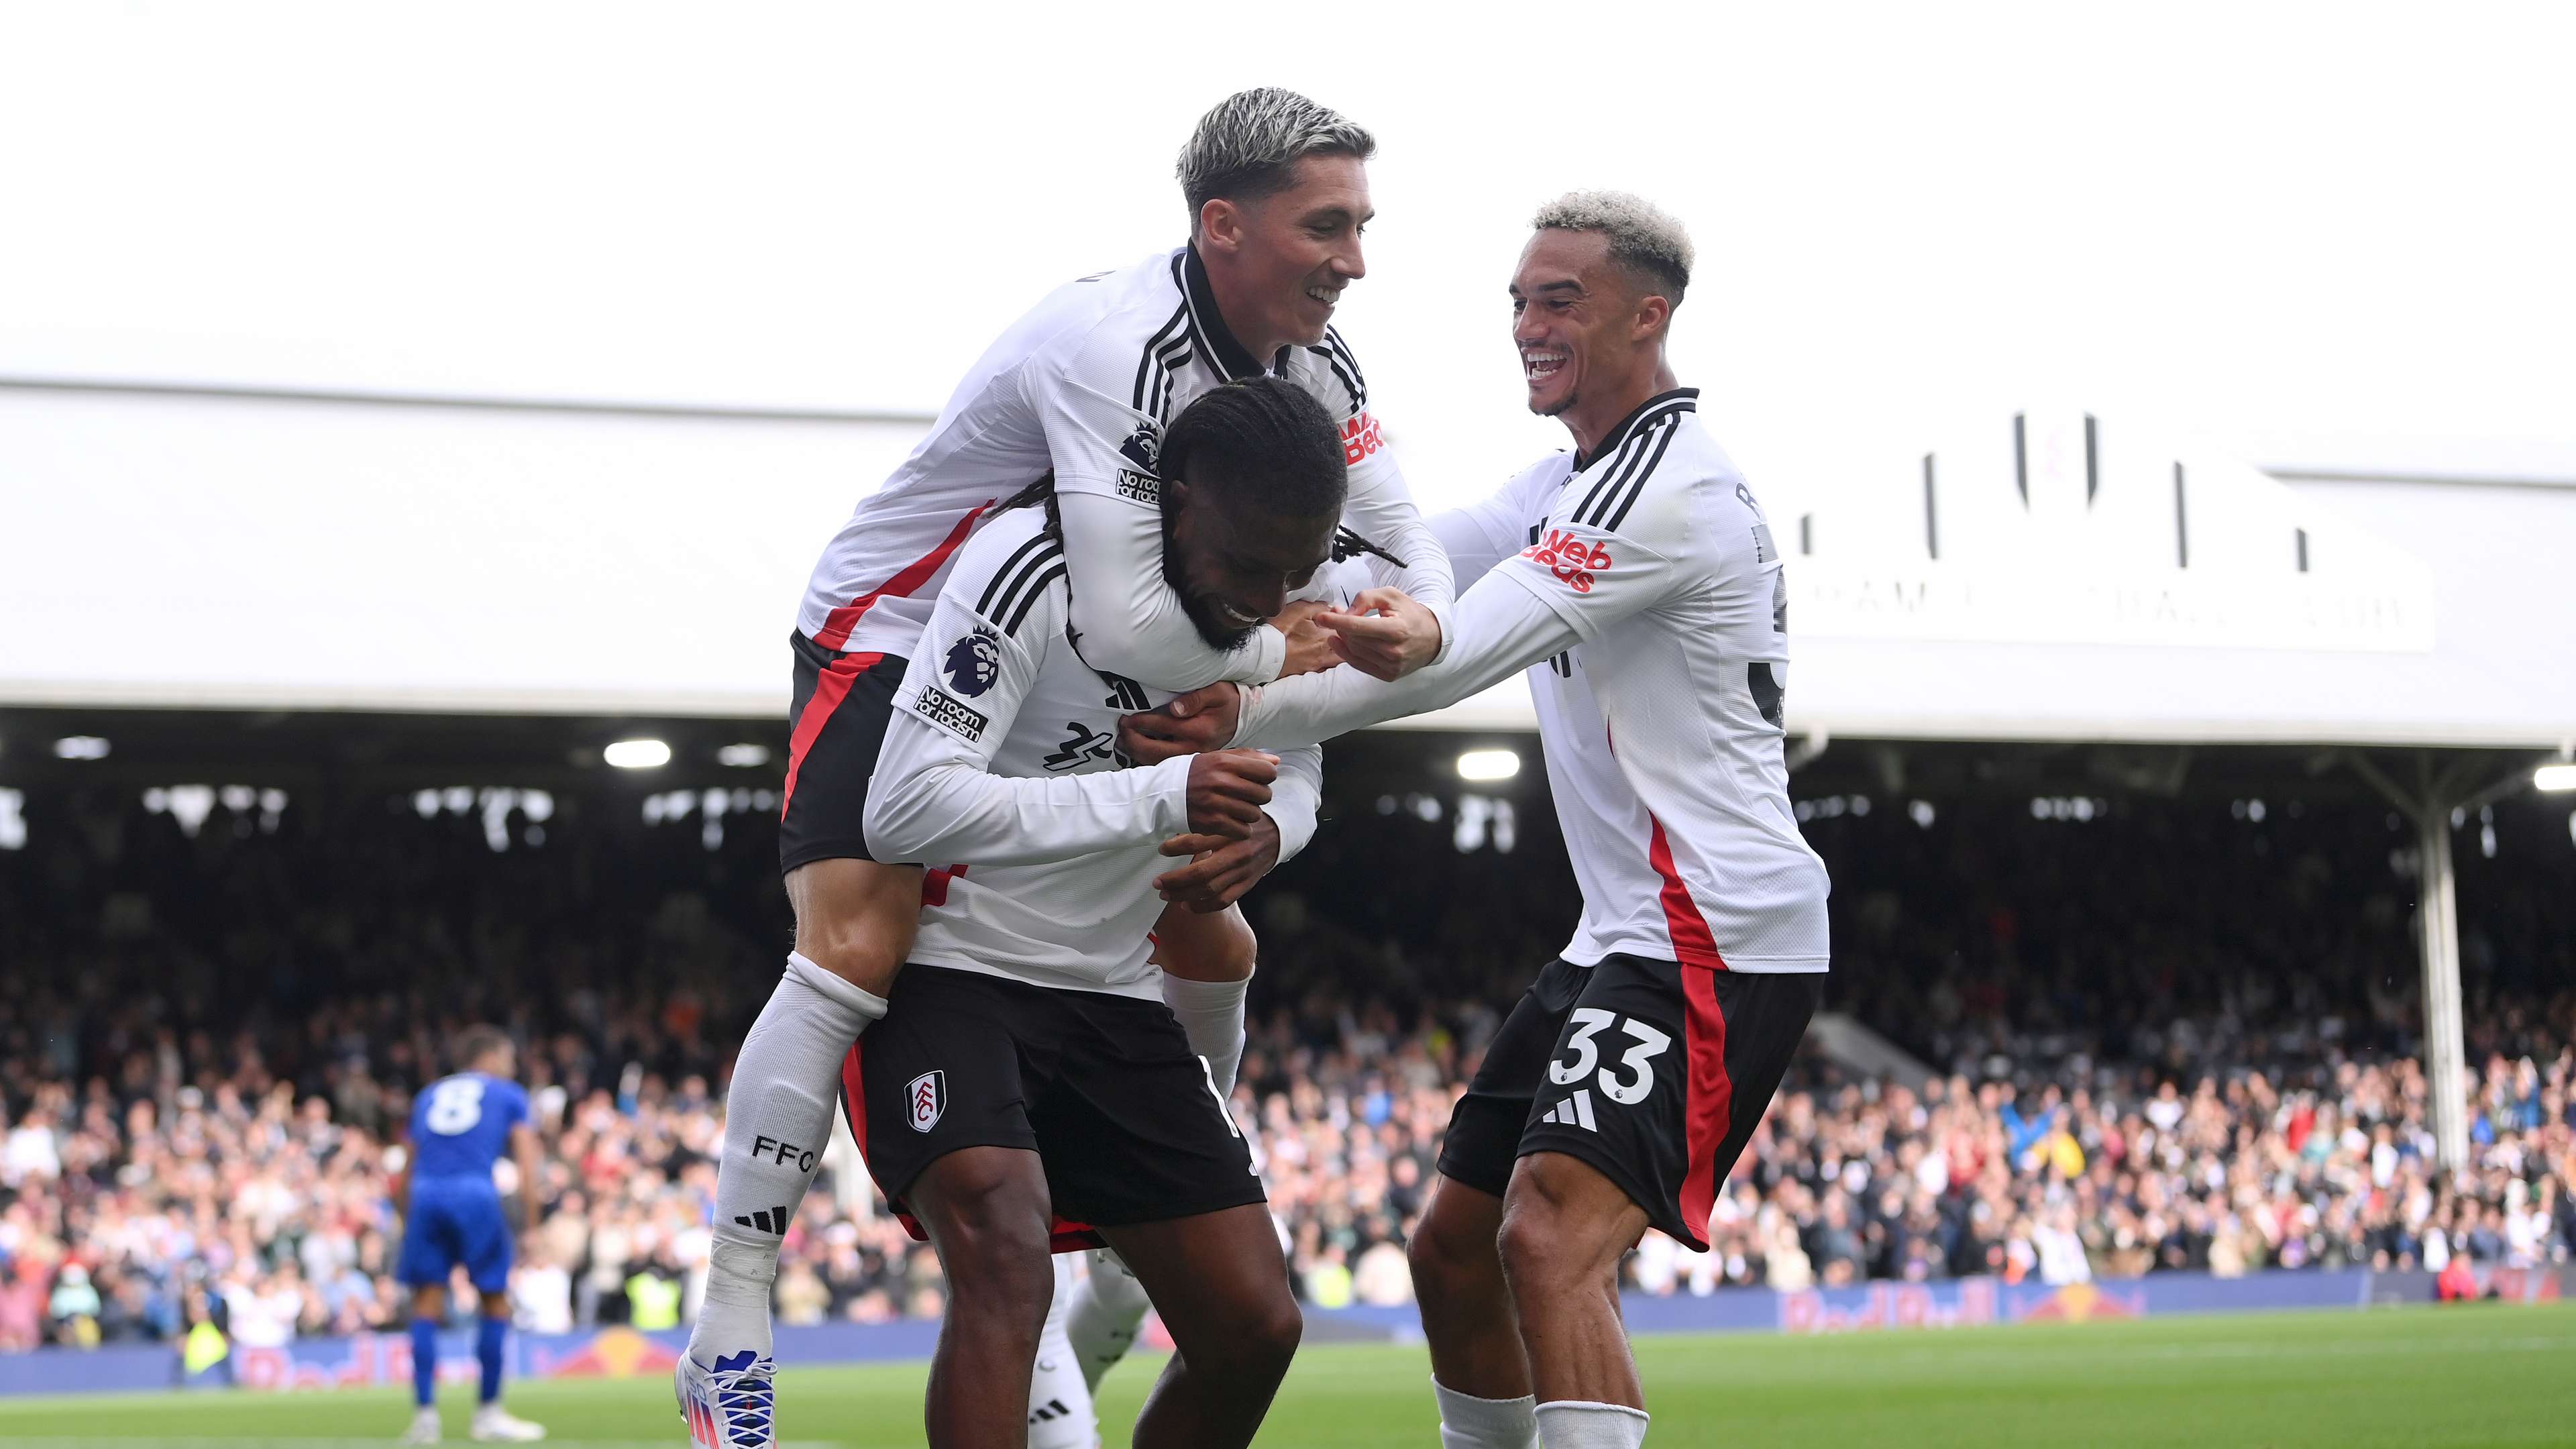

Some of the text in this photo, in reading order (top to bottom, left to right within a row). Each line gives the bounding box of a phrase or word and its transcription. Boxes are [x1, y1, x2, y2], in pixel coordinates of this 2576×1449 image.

[1116, 482, 1136, 498] for
[1118, 469, 1161, 493] No roo
[1543, 529, 1612, 570] Web
[914, 697, 980, 742] for racism
[920, 686, 980, 728] No room
[1550, 1008, 1672, 1105] 33
[426, 1077, 486, 1136] 8
[915, 1081, 934, 1121] FFC
[752, 1135, 814, 1173] FFC
